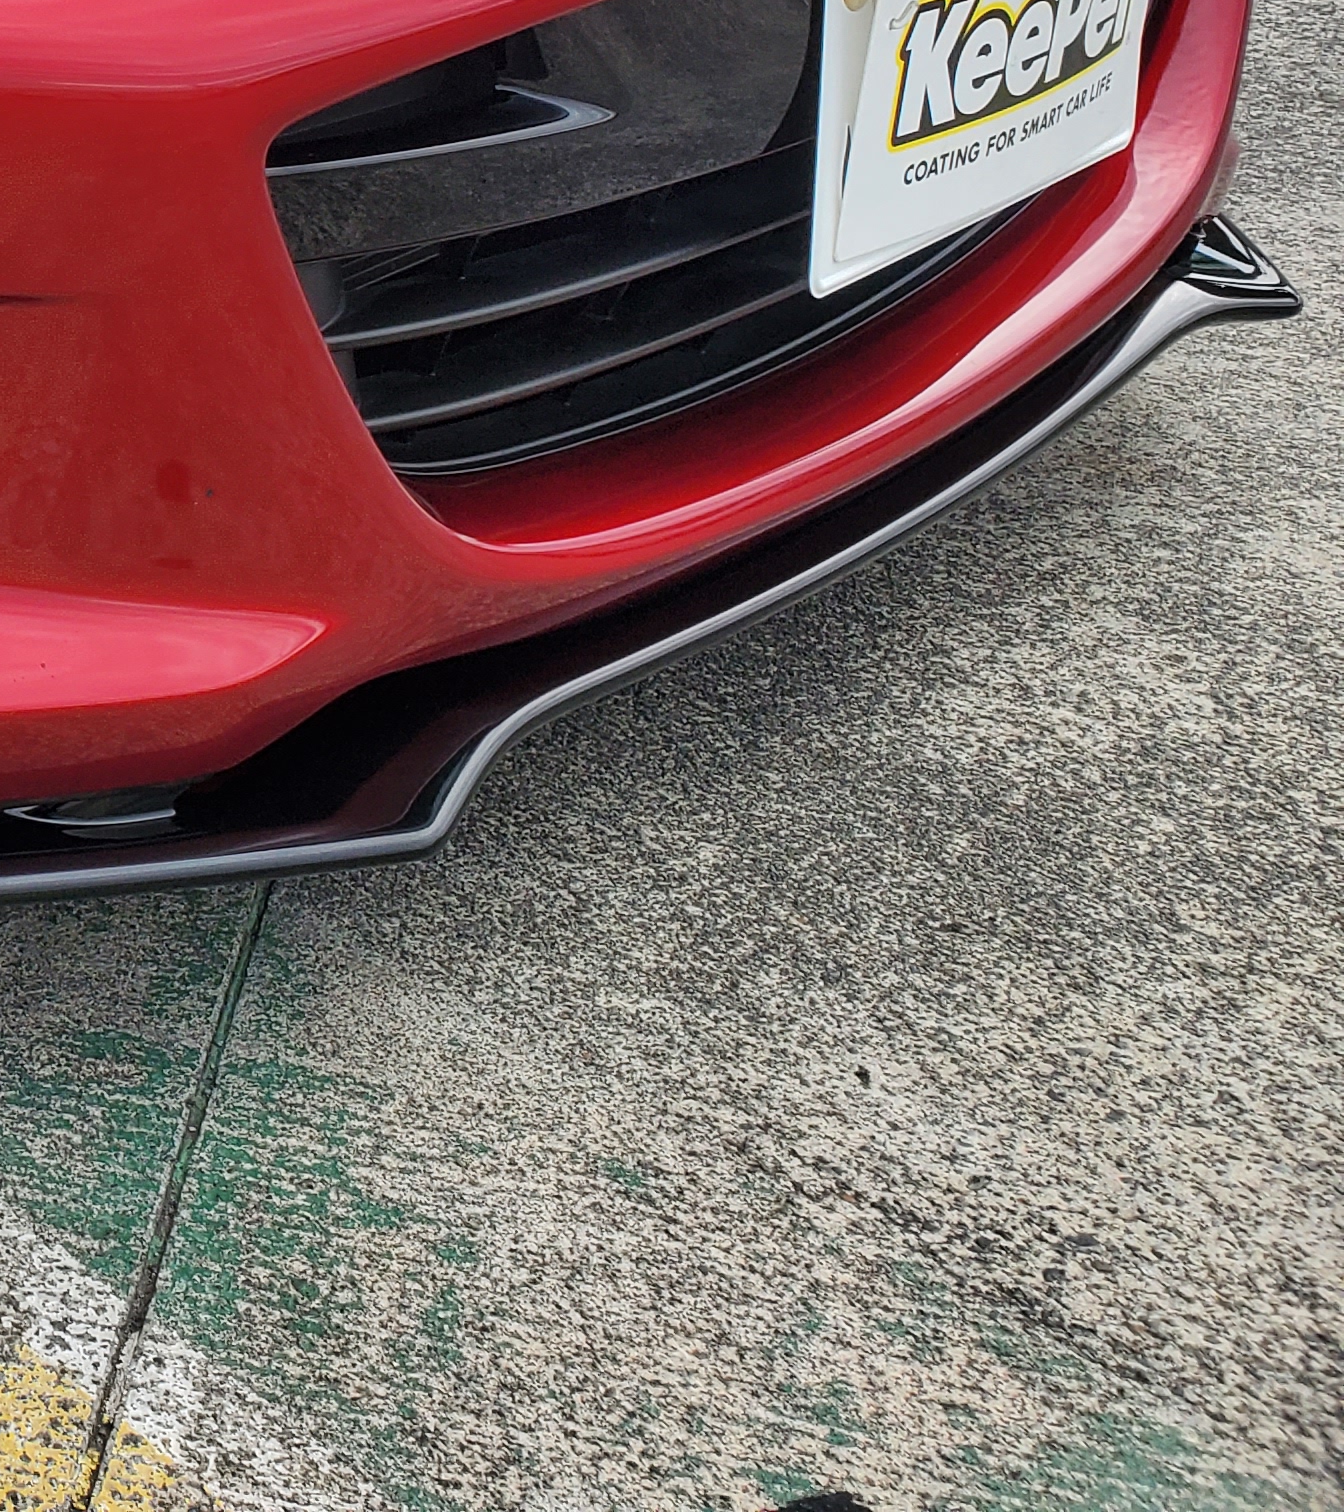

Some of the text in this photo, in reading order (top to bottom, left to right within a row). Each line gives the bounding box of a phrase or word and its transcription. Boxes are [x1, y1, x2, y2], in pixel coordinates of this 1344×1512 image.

[902, 71, 1113, 186] COATING FOR SMART CAR LIFE
